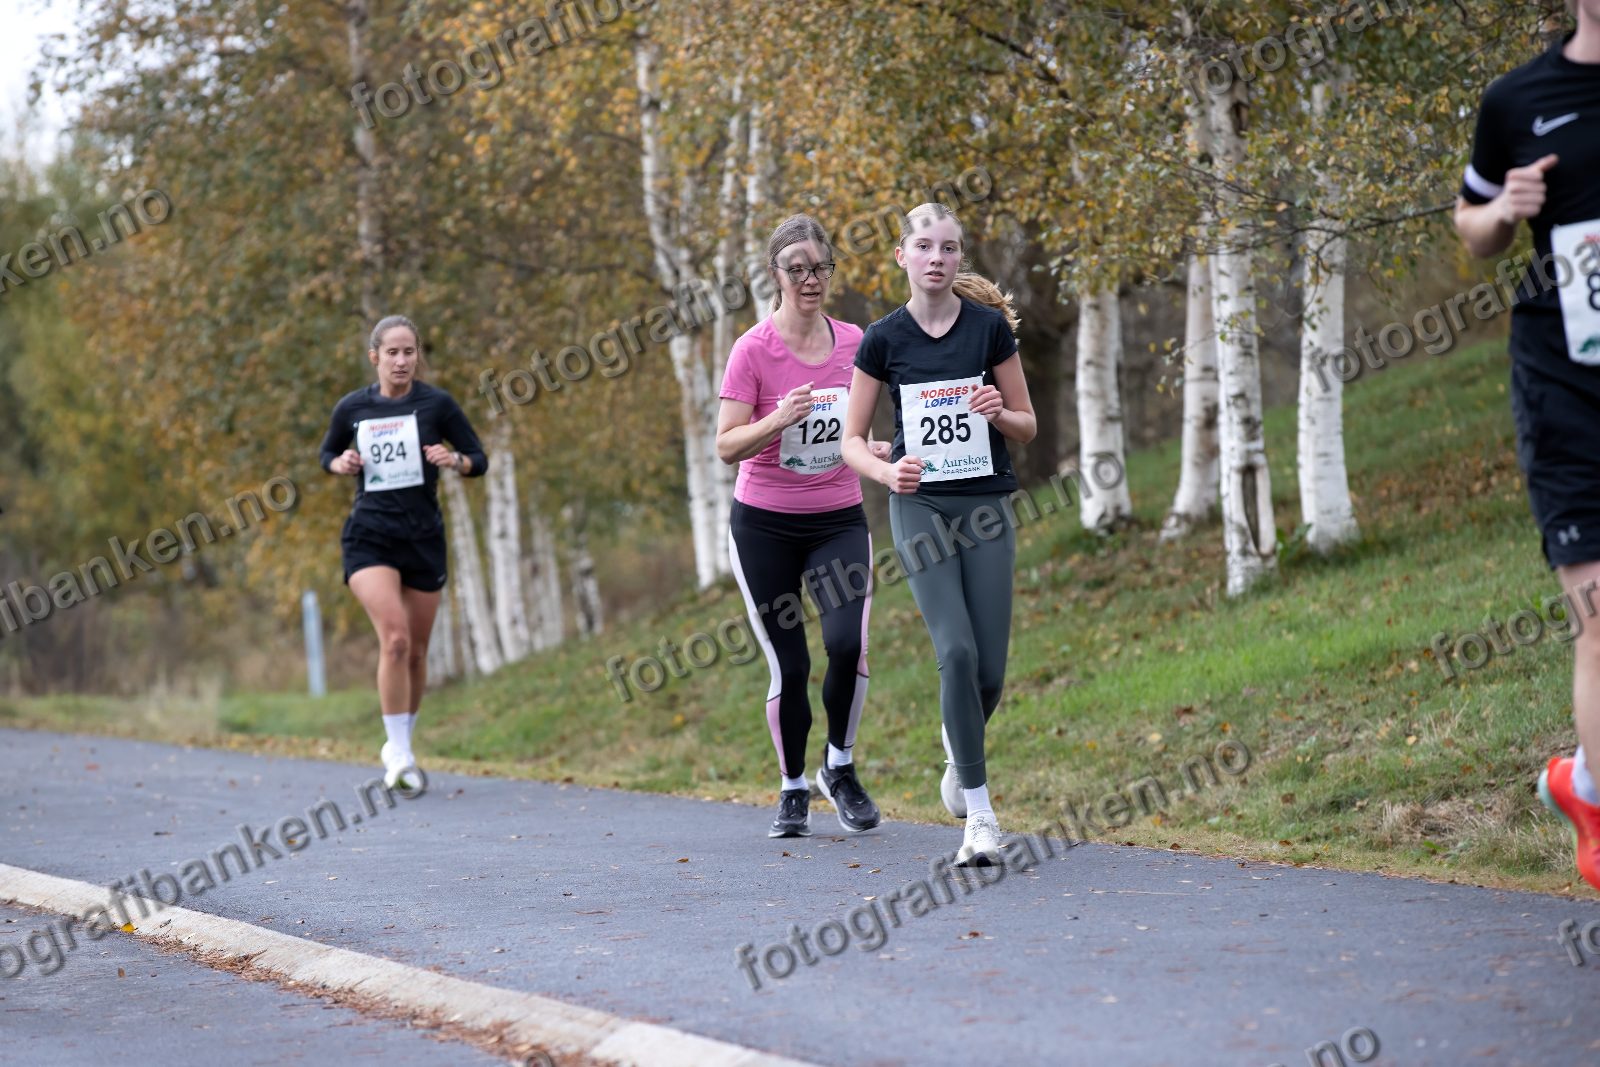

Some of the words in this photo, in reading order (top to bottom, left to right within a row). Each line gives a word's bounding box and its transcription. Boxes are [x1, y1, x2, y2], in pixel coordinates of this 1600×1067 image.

[920, 386, 969, 399] NORGES
[924, 396, 962, 408] LØPET
[798, 417, 841, 445] 122
[920, 412, 971, 446] 285
[370, 440, 407, 464] 924
[941, 454, 989, 468] Aurskog
